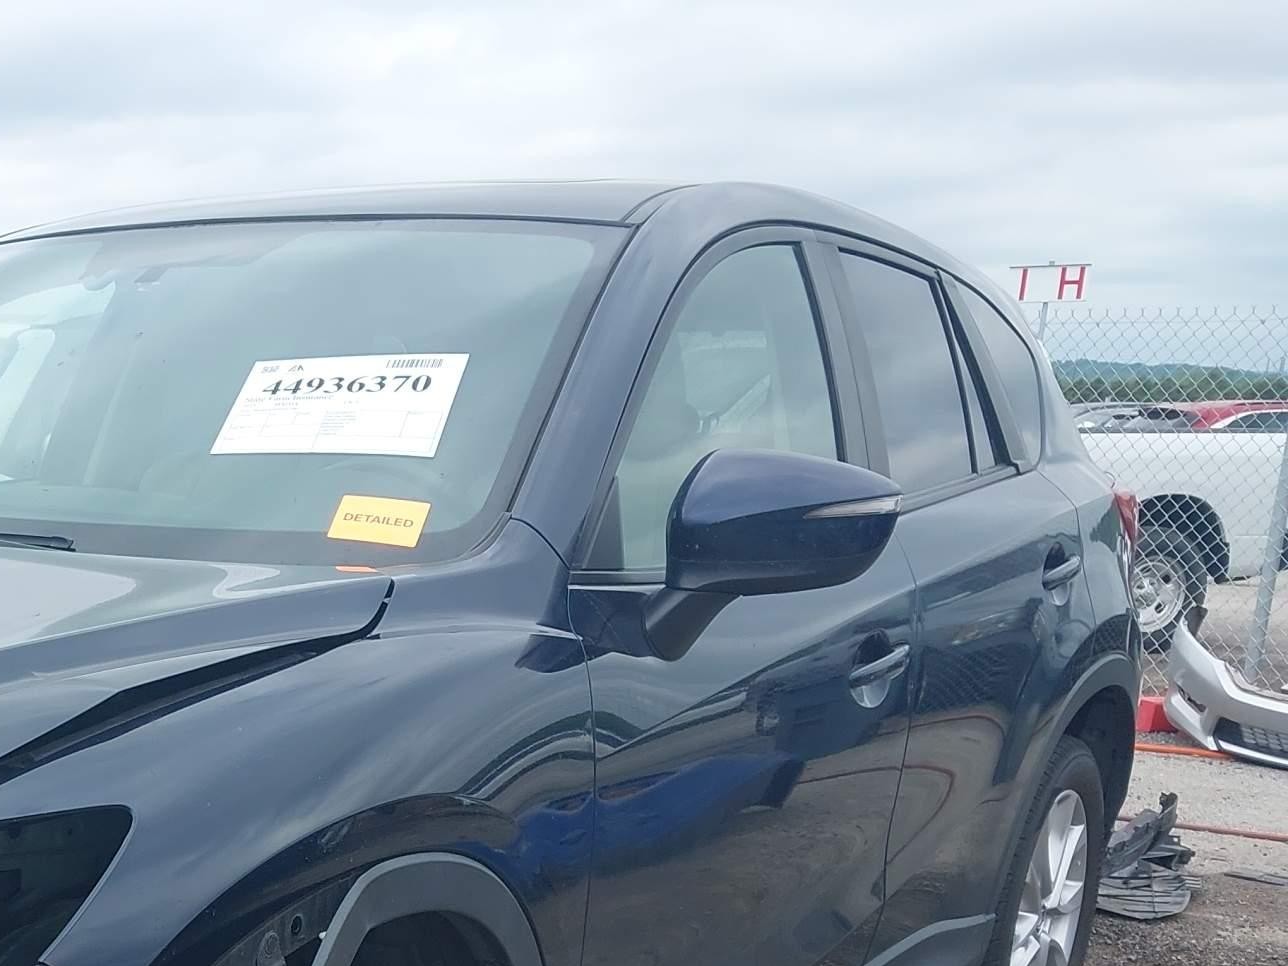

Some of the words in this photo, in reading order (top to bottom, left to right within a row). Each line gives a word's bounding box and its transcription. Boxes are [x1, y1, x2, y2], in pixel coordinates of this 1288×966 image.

[1057, 266, 1086, 300] H
[261, 374, 433, 395] 44936370
[343, 512, 414, 528] DETAILED
